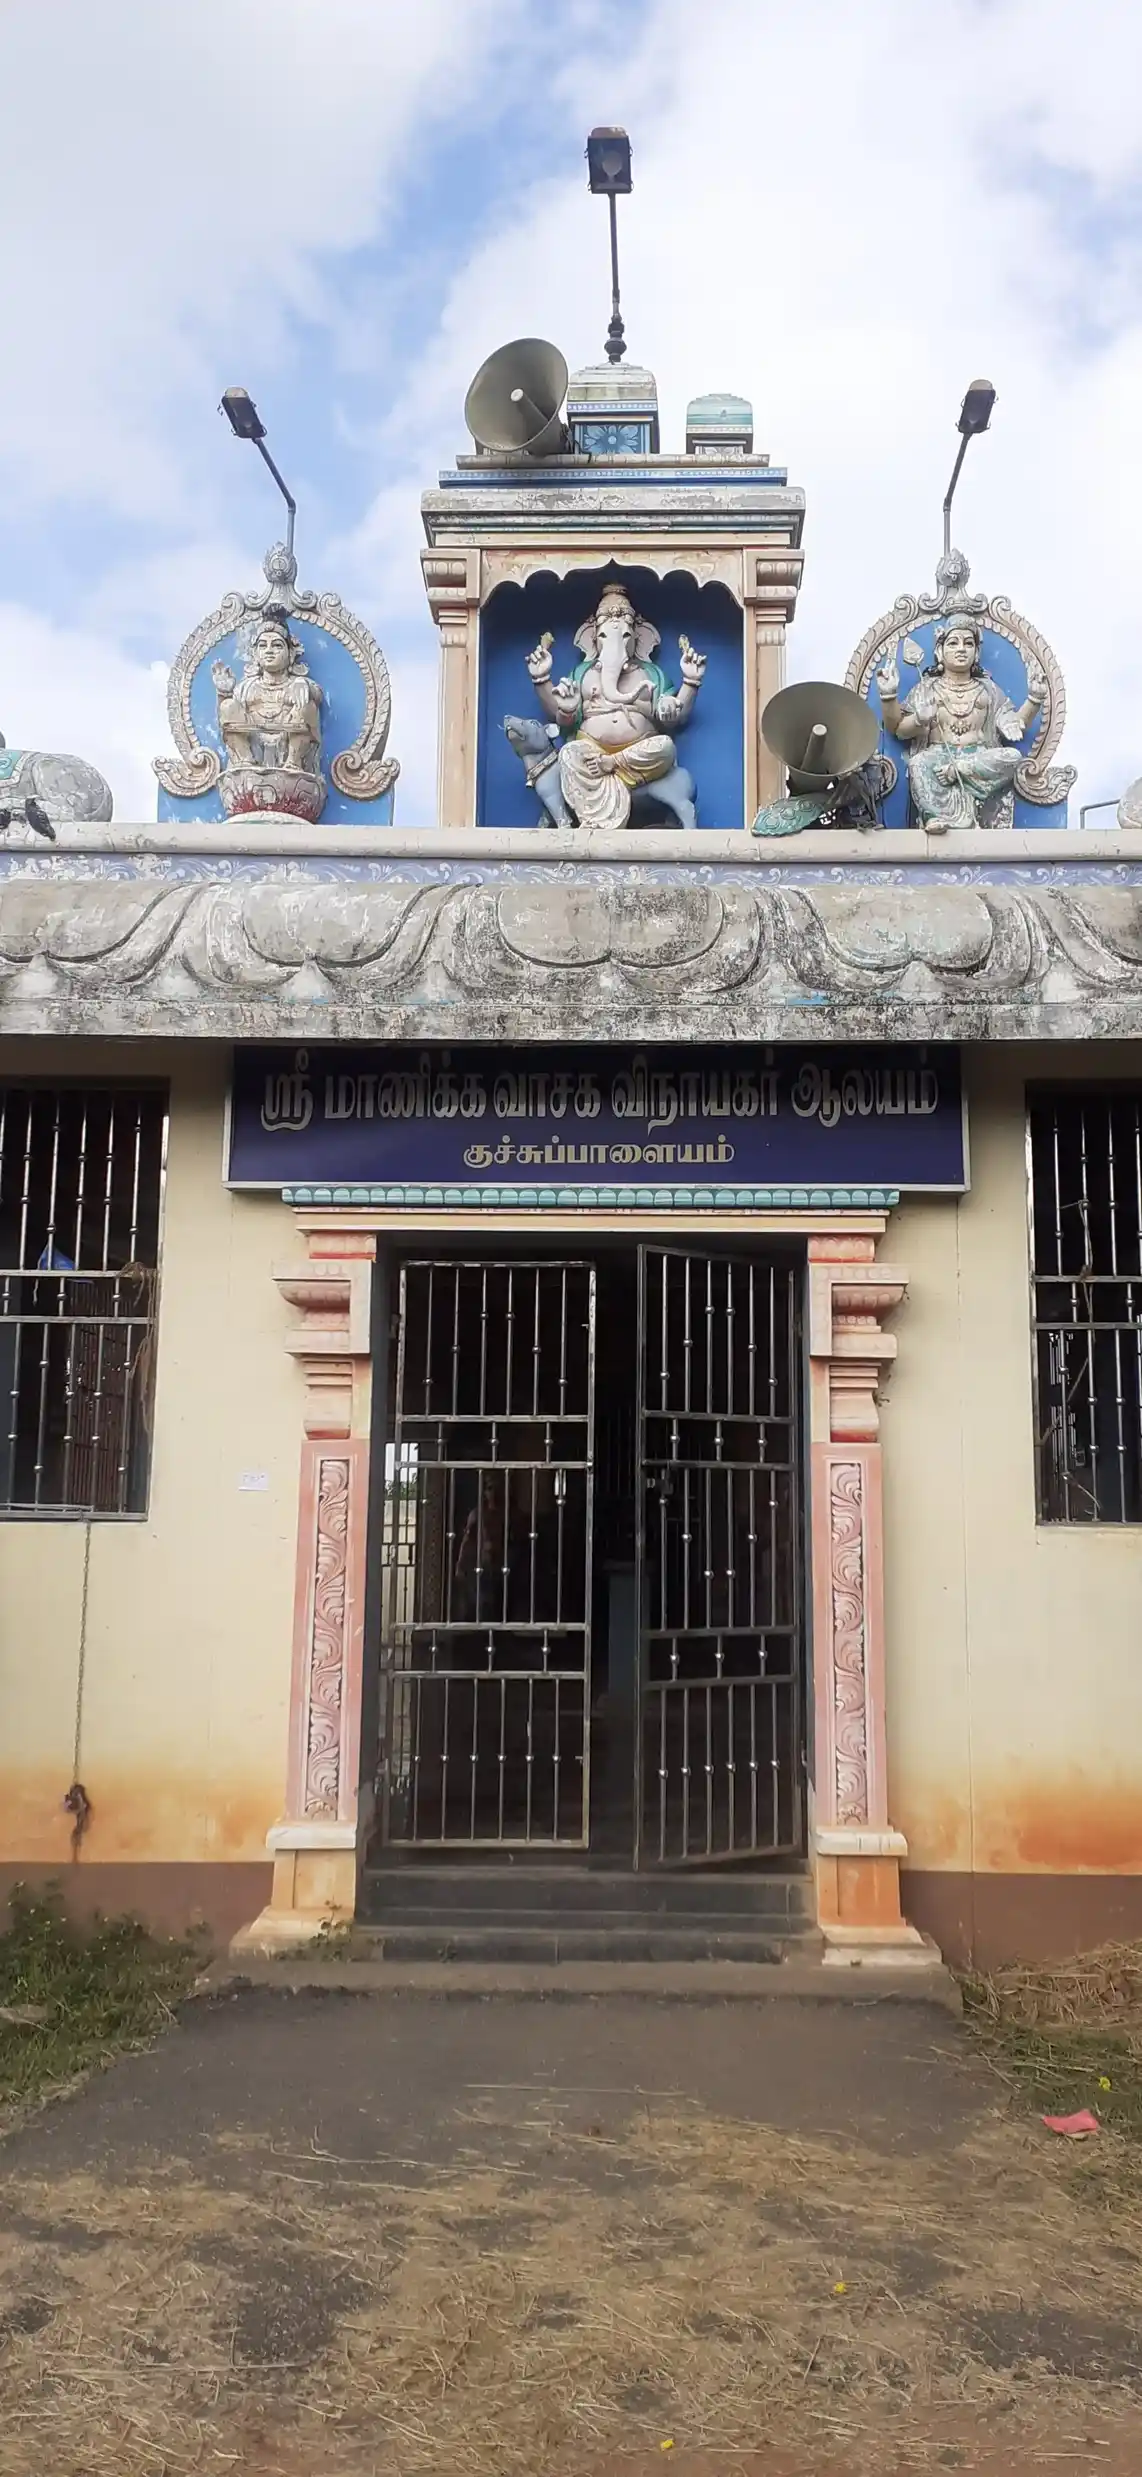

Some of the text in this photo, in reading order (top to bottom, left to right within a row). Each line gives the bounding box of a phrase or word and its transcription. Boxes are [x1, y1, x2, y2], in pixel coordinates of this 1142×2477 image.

[611, 1047, 779, 1135] விநாயகர்
[791, 1047, 939, 1127] ஆலயம்
[463, 1135, 734, 1169] குச்சுப்பாளையம்
